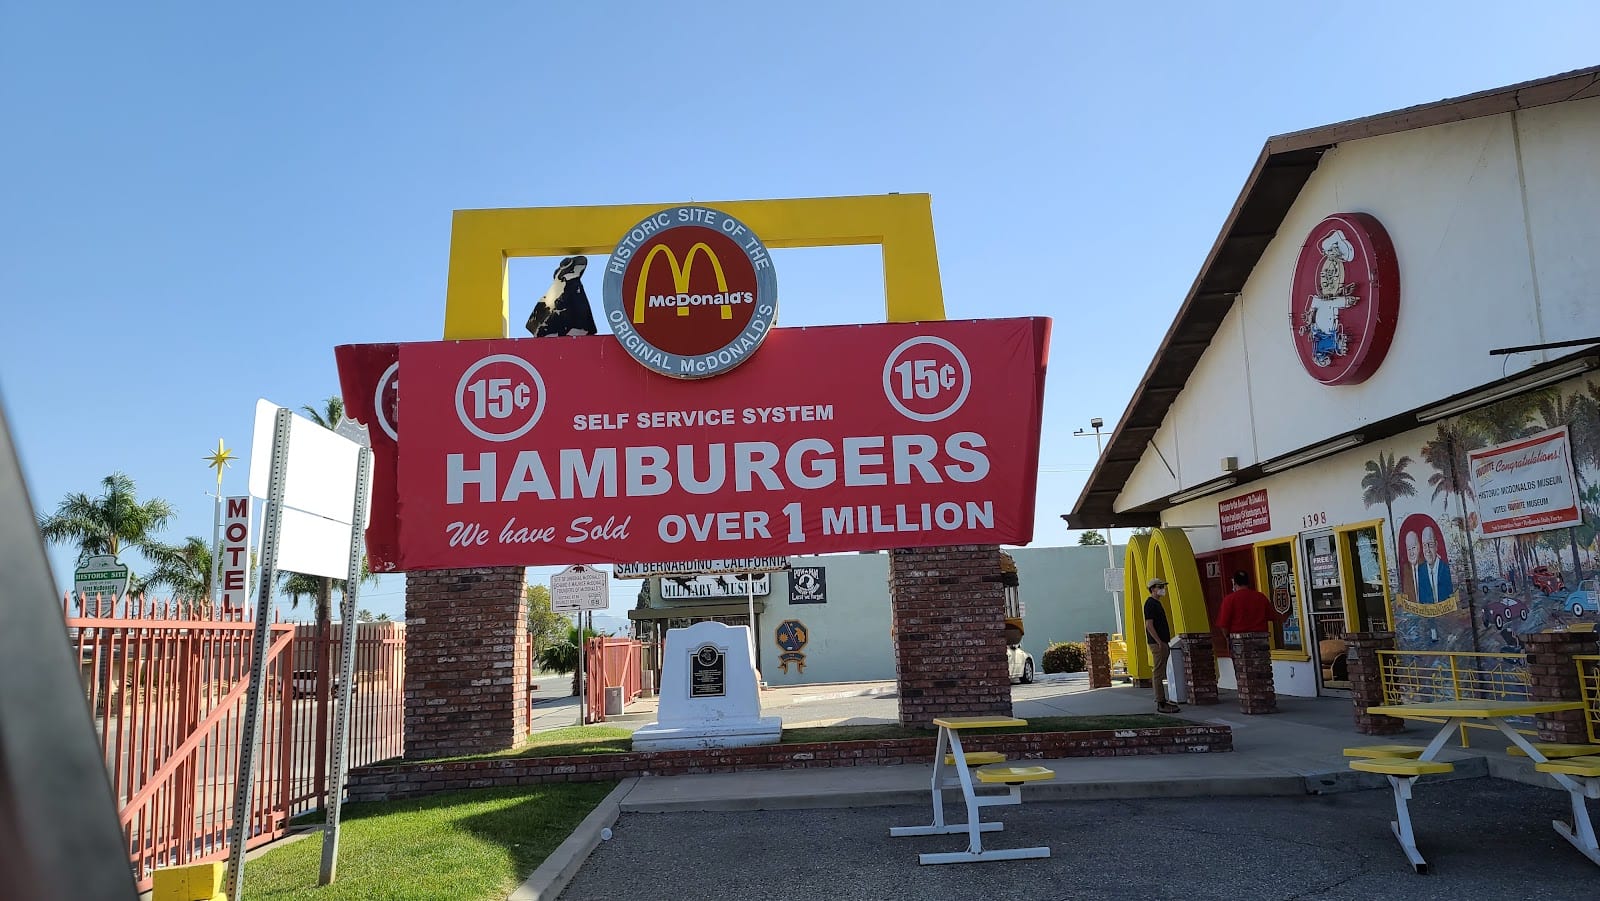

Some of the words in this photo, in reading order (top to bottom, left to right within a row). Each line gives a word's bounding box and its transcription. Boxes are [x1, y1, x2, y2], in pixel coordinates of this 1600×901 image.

[609, 212, 671, 275] HISTORIC
[678, 208, 717, 225] SITE
[721, 218, 746, 238] OF
[745, 236, 770, 271] THE
[648, 291, 754, 308] McDonald's
[609, 309, 672, 370] ORIGINAL
[679, 303, 773, 372] McDONALD'S
[894, 359, 956, 400] 15¢
[467, 378, 531, 420] 15¢
[573, 412, 629, 431] SELF
[636, 408, 736, 429] SERVICE
[742, 404, 834, 424] SYSTEM
[446, 431, 991, 505] HAMBURGERS
[1495, 448, 1561, 474] Congratulations!
[1478, 487, 1500, 500] HISTORIC
[1537, 475, 1563, 489] MUSEUM
[1526, 497, 1549, 509] MUSEUM
[445, 520, 490, 548] We
[498, 516, 556, 545] have
[565, 514, 632, 544] Sold
[657, 510, 773, 544] OVER
[782, 502, 806, 544] 1
[821, 500, 995, 536] MILLION
[1302, 511, 1327, 529] 1398
[224, 498, 248, 614] MOTEL
[617, 562, 639, 574] SAN
[642, 559, 713, 572] BERNARDINO
[723, 555, 787, 569] CALIFORNIA
[665, 583, 712, 597] MILTARY
